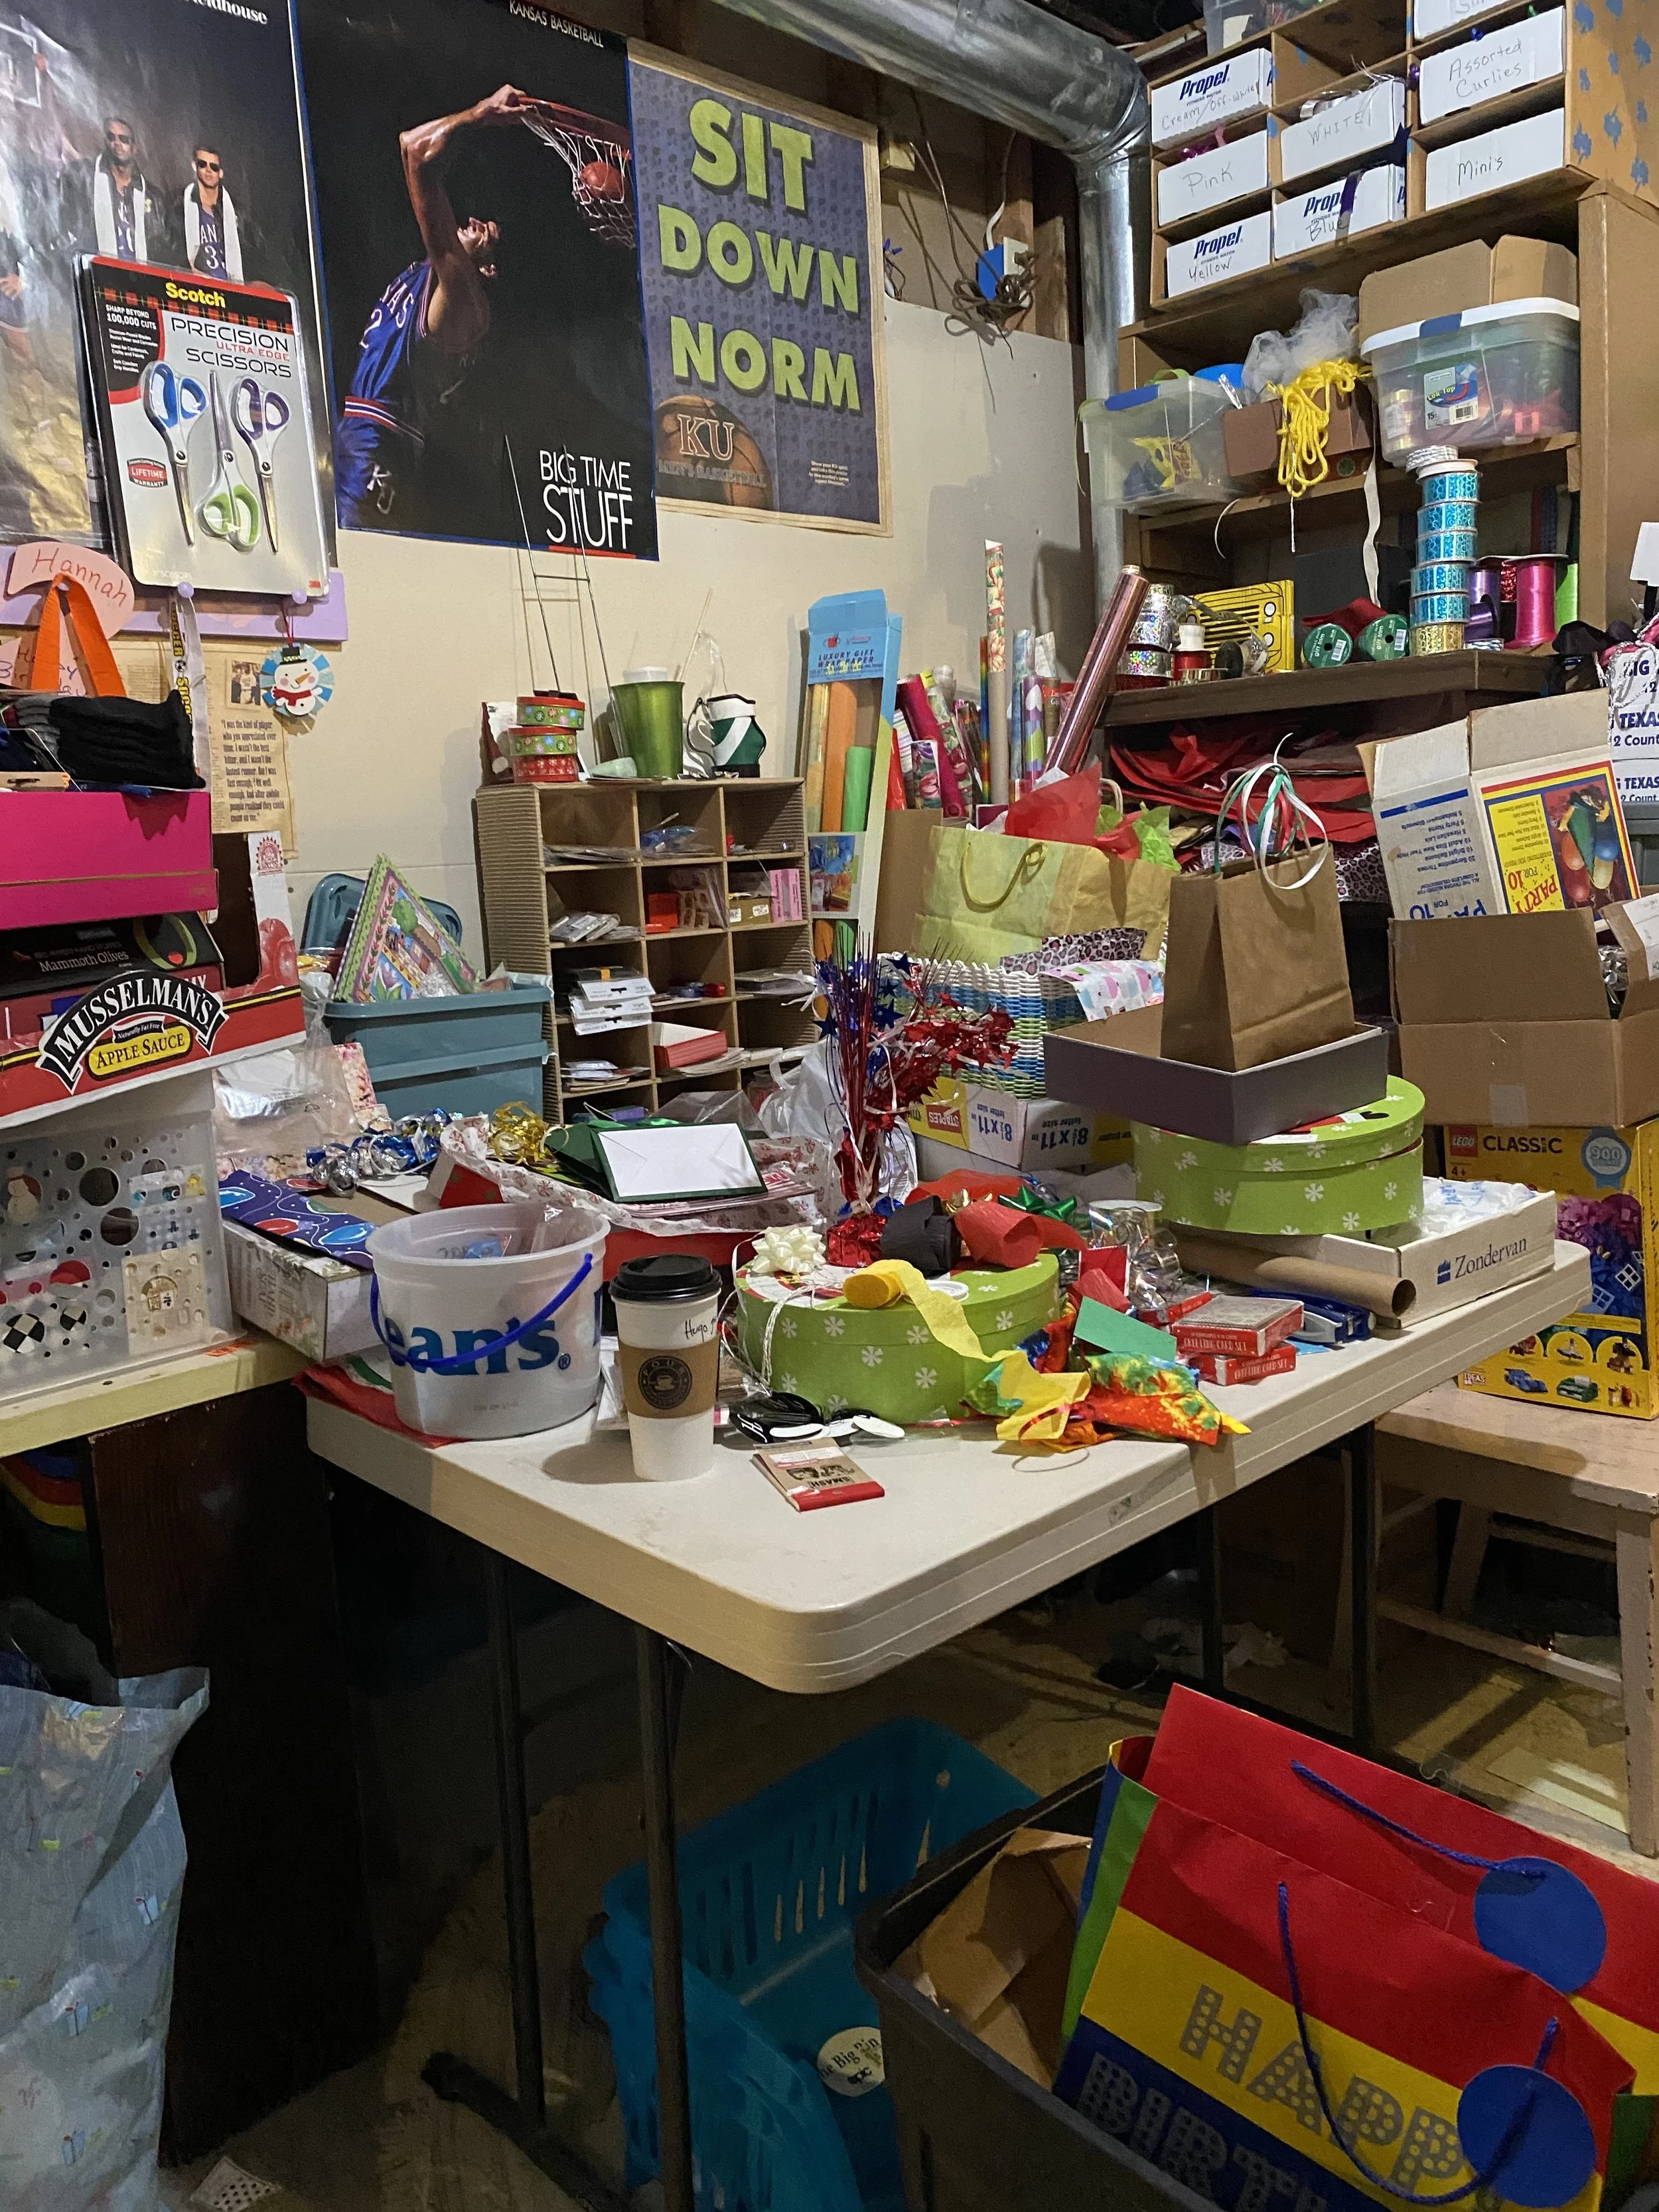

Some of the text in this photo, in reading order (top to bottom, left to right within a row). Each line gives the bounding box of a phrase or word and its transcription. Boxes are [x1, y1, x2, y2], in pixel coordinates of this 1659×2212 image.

[186, 0, 267, 25] eldhouse
[510, 0, 604, 48] KANSAS BASKETBALL
[1449, 38, 1522, 82] Assorted
[1179, 64, 1230, 101] Propel
[1456, 63, 1522, 98] Curlies
[689, 99, 814, 214] SIT
[1183, 161, 1233, 197] Pink
[1459, 156, 1503, 186] Mini's
[1303, 192, 1340, 218] Prop
[1194, 226, 1243, 259] Propel
[1305, 218, 1349, 242] Blue
[658, 204, 860, 315] DOWN
[1189, 256, 1232, 283] Yellow
[166, 282, 226, 309] Scotch
[106, 304, 149, 319] SHARP BEYOND
[107, 313, 157, 331] 100,000 CUTS
[171, 317, 289, 352] PRECISION
[186, 348, 292, 378] SCISSORS
[216, 342, 289, 362] ULTRA EDGE
[671, 316, 861, 411] NORM
[1427, 411, 1435, 420] 15
[677, 413, 735, 461] KU
[131, 467, 164, 479] LIFETIME
[133, 477, 165, 487] WARRANTY
[540, 450, 632, 492] BIG TIME
[659, 459, 767, 488] MEN'S BASKETBALL
[543, 483, 632, 550] STUFF
[32, 548, 127, 607] Hannah
[171, 601, 185, 656] SOCCER
[819, 648, 875, 661] LUXURY GIFT
[845, 656, 874, 665] PAPER
[177, 676, 193, 725] SOCC
[1624, 735, 1659, 747] Count
[1508, 866, 1539, 891] FOR 10
[1433, 899, 1449, 909] FOR
[1515, 873, 1558, 914] PARTY
[1409, 903, 1435, 921] 10
[40, 958, 96, 973] Mammoth
[98, 949, 130, 964] Olives
[55, 977, 213, 1063] MUSSELMAN'S
[117, 1022, 161, 1040] Naturally Fat Free
[96, 1033, 185, 1069] APPLE SAUCE
[928, 1111, 960, 1128] STAPLES
[977, 1102, 1005, 1119] letter size
[1042, 1116, 1082, 1129] letter size
[1451, 1135, 1563, 1154] LEGO CLASSIC
[1590, 1146, 1623, 1160] 900
[1451, 1166, 1467, 1176] 4+
[1455, 1238, 1527, 1279] Zondervan
[684, 1319, 708, 1343] Hugo
[385, 1317, 560, 1376] ean's
[1183, 1337, 1248, 1352] GREETING CARD SET
[1234, 1359, 1287, 1380] GREETING CARD SET
[1464, 1372, 1486, 1383] IDEAS
[810, 1476, 851, 1489] SMASH
[832, 2051, 861, 2069] Big
[847, 2067, 873, 2084] epic
[1178, 1984, 1502, 2212] HAPP
[1075, 2051, 1329, 2212] BIRT
